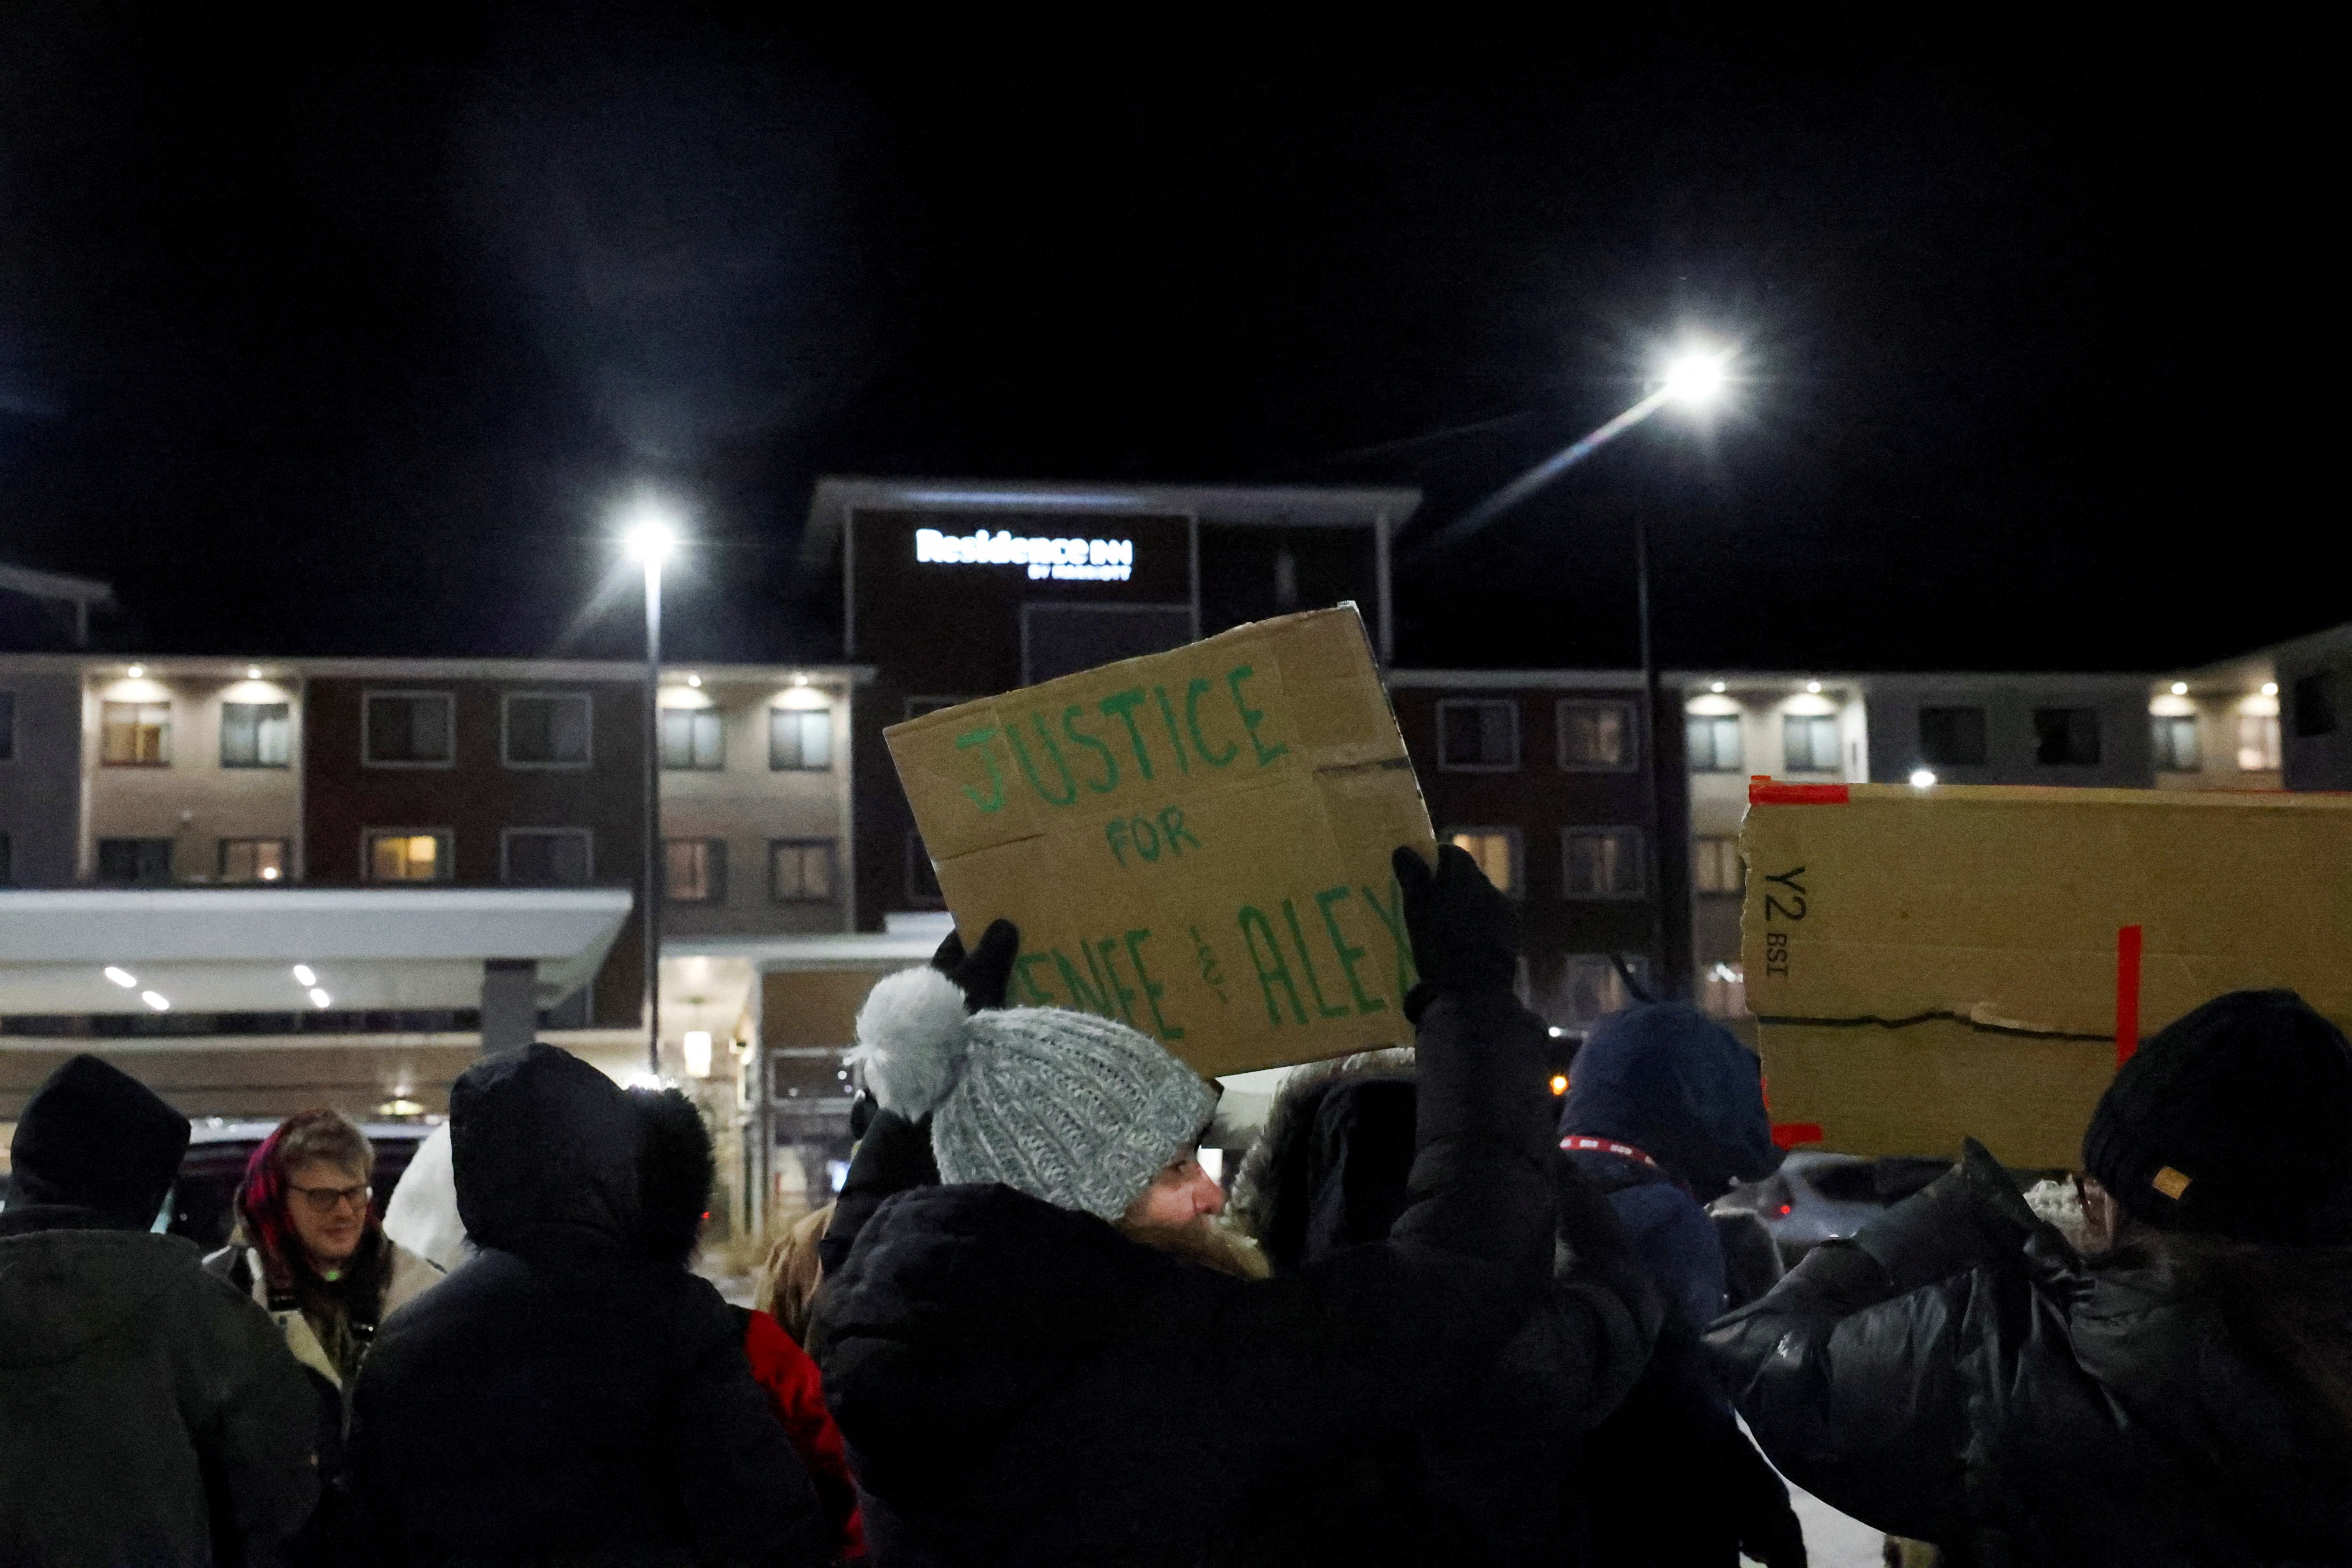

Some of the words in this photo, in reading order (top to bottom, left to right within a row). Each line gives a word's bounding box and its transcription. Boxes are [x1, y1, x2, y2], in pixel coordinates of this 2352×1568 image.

[916, 529, 1089, 564] Residence
[956, 666, 1288, 812] JUSTICE
[1105, 805, 1201, 866] FOR
[1764, 866, 1806, 921] Y2
[1007, 928, 1184, 1039] ENEE
[1766, 933, 1788, 978] BSI
